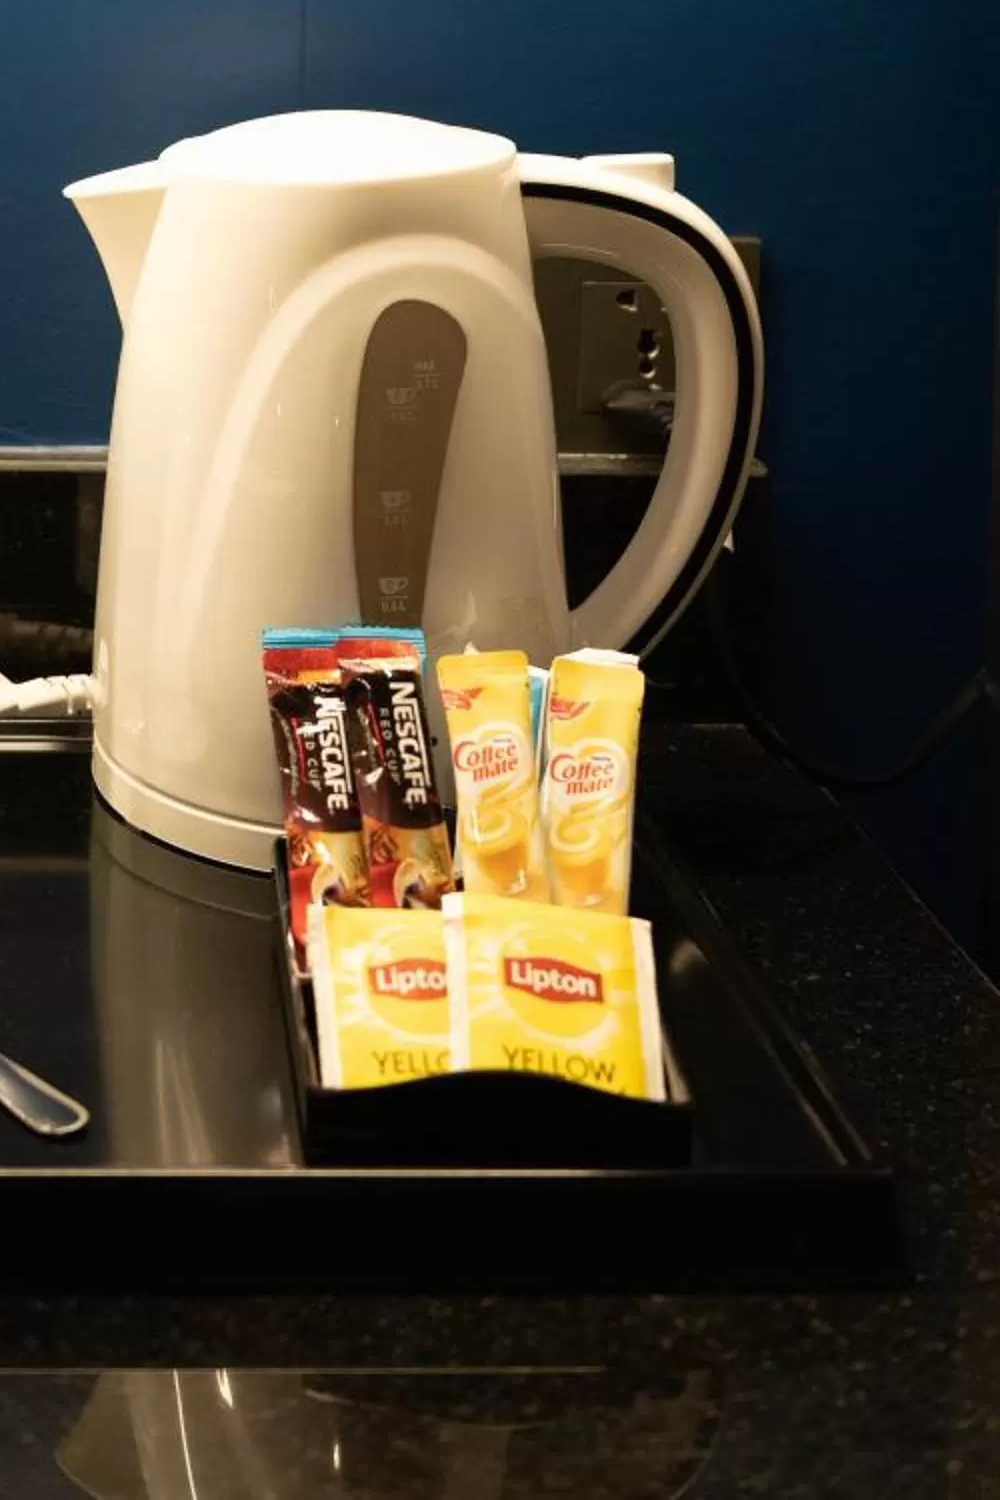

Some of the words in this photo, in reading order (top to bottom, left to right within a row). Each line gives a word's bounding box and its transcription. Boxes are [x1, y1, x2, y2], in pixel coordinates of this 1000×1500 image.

[453, 740, 517, 772] Coffee
[472, 756, 519, 782] mate
[550, 753, 614, 782] Coffee
[565, 776, 613, 796] mate
[375, 966, 448, 995] Lipto
[510, 960, 598, 997] Lipton
[502, 1044, 616, 1084] YELLOW
